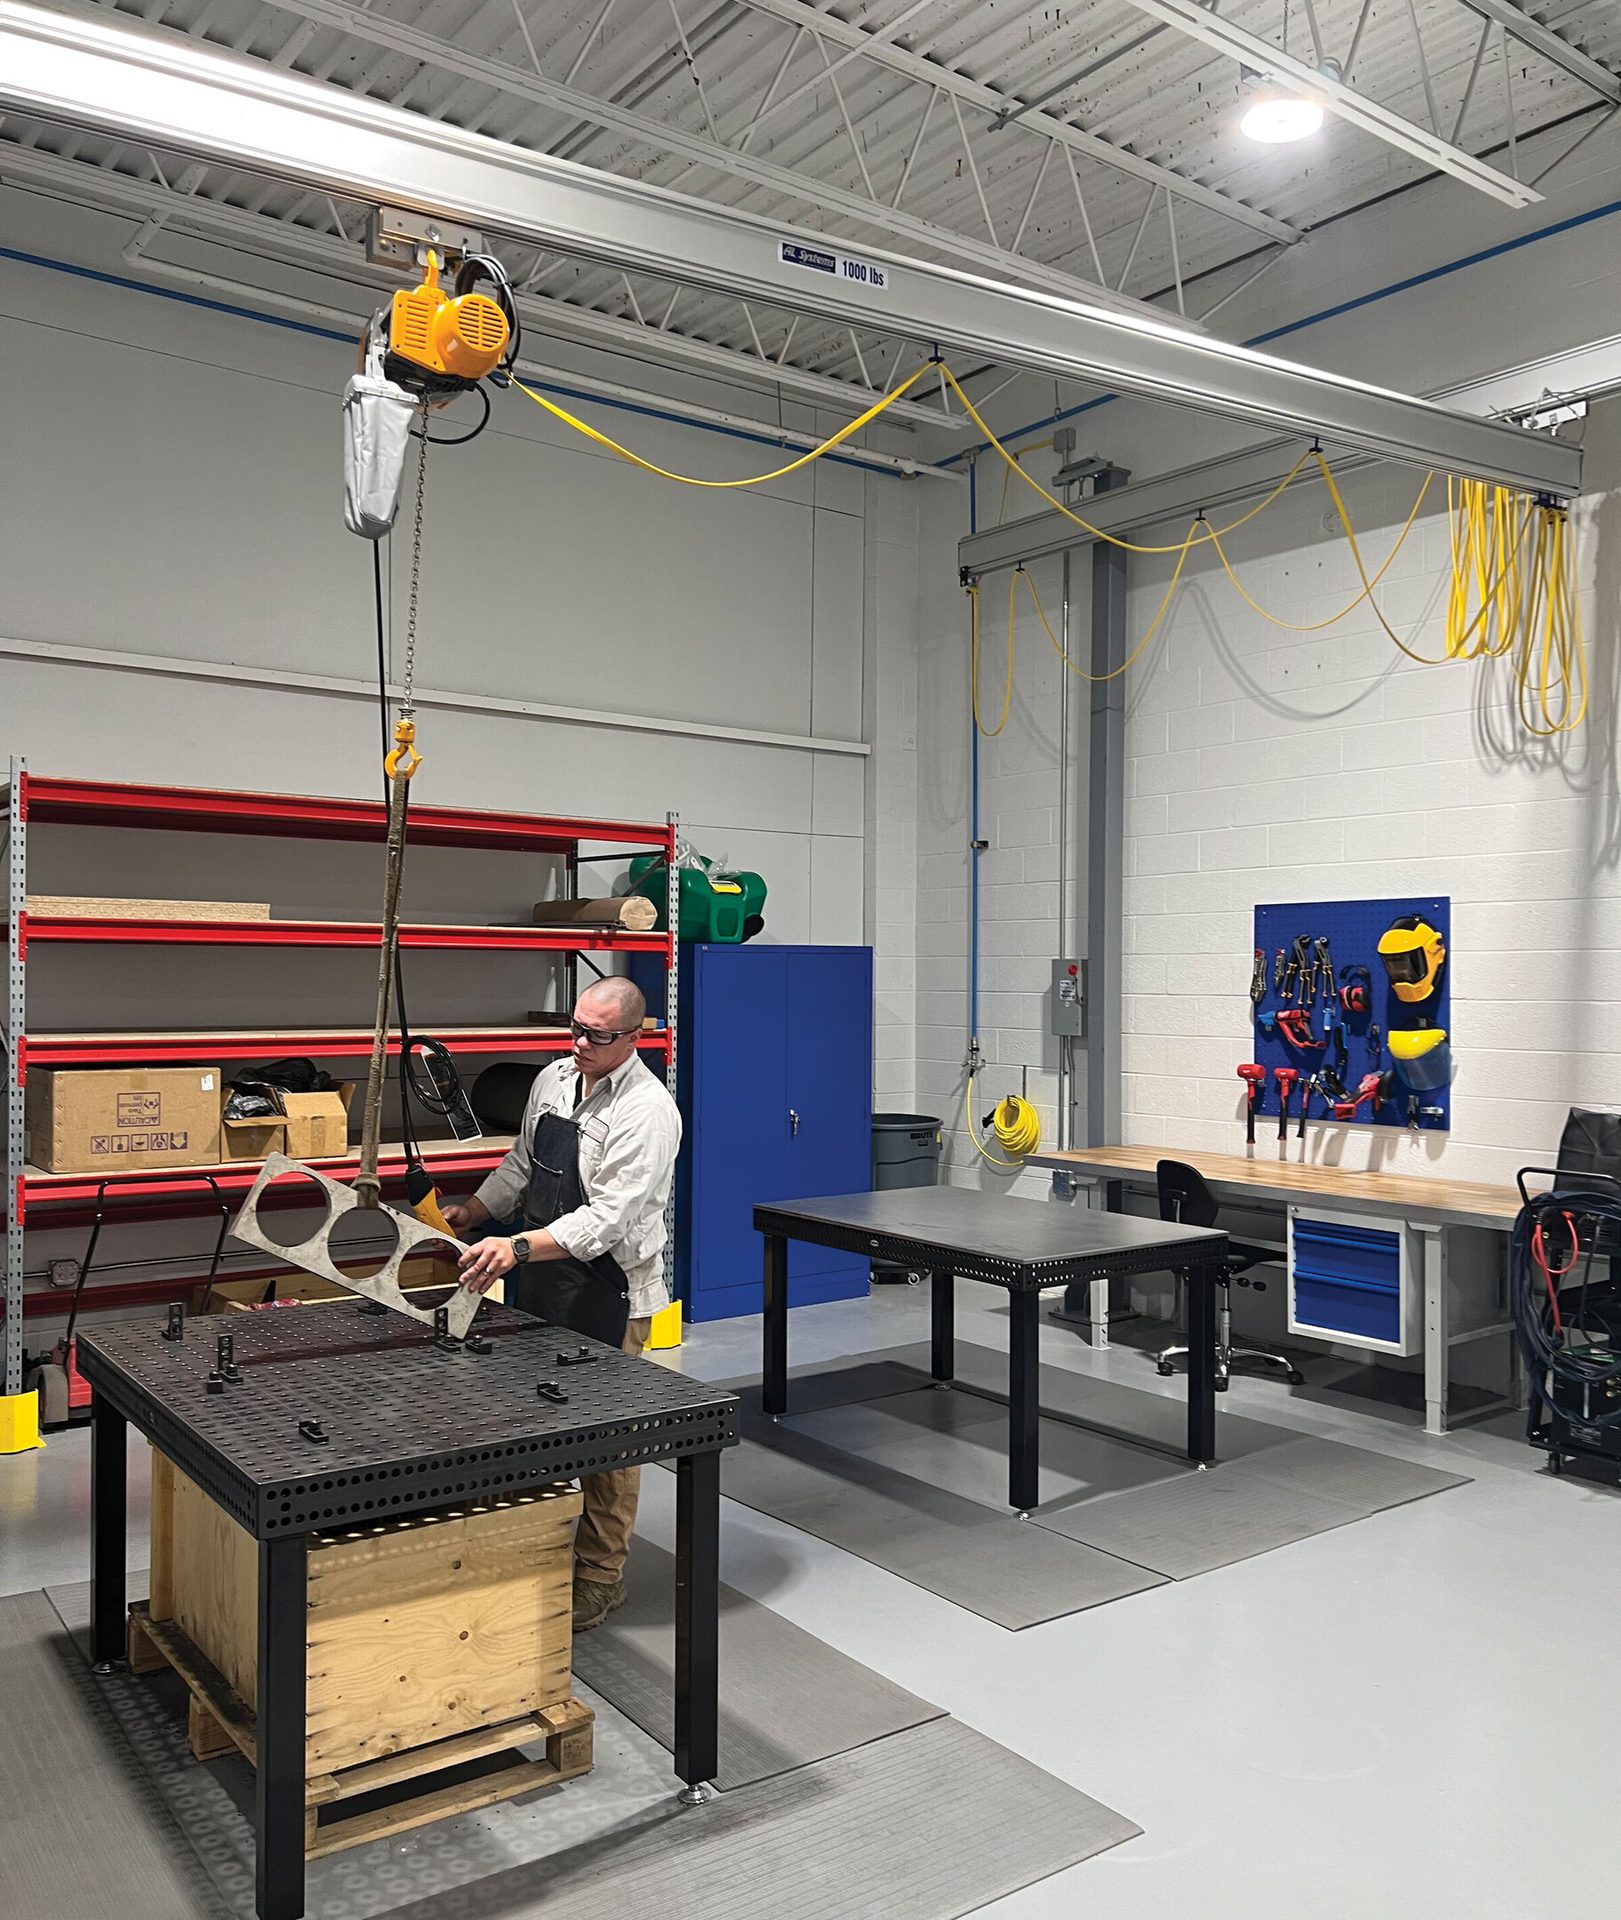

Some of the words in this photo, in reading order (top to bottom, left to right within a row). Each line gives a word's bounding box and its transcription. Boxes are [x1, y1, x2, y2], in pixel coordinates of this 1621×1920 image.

[799, 250, 834, 267] Systems
[842, 260, 867, 281] 1000
[869, 267, 884, 286] lbs
[118, 1117, 150, 1125] CAUTION
